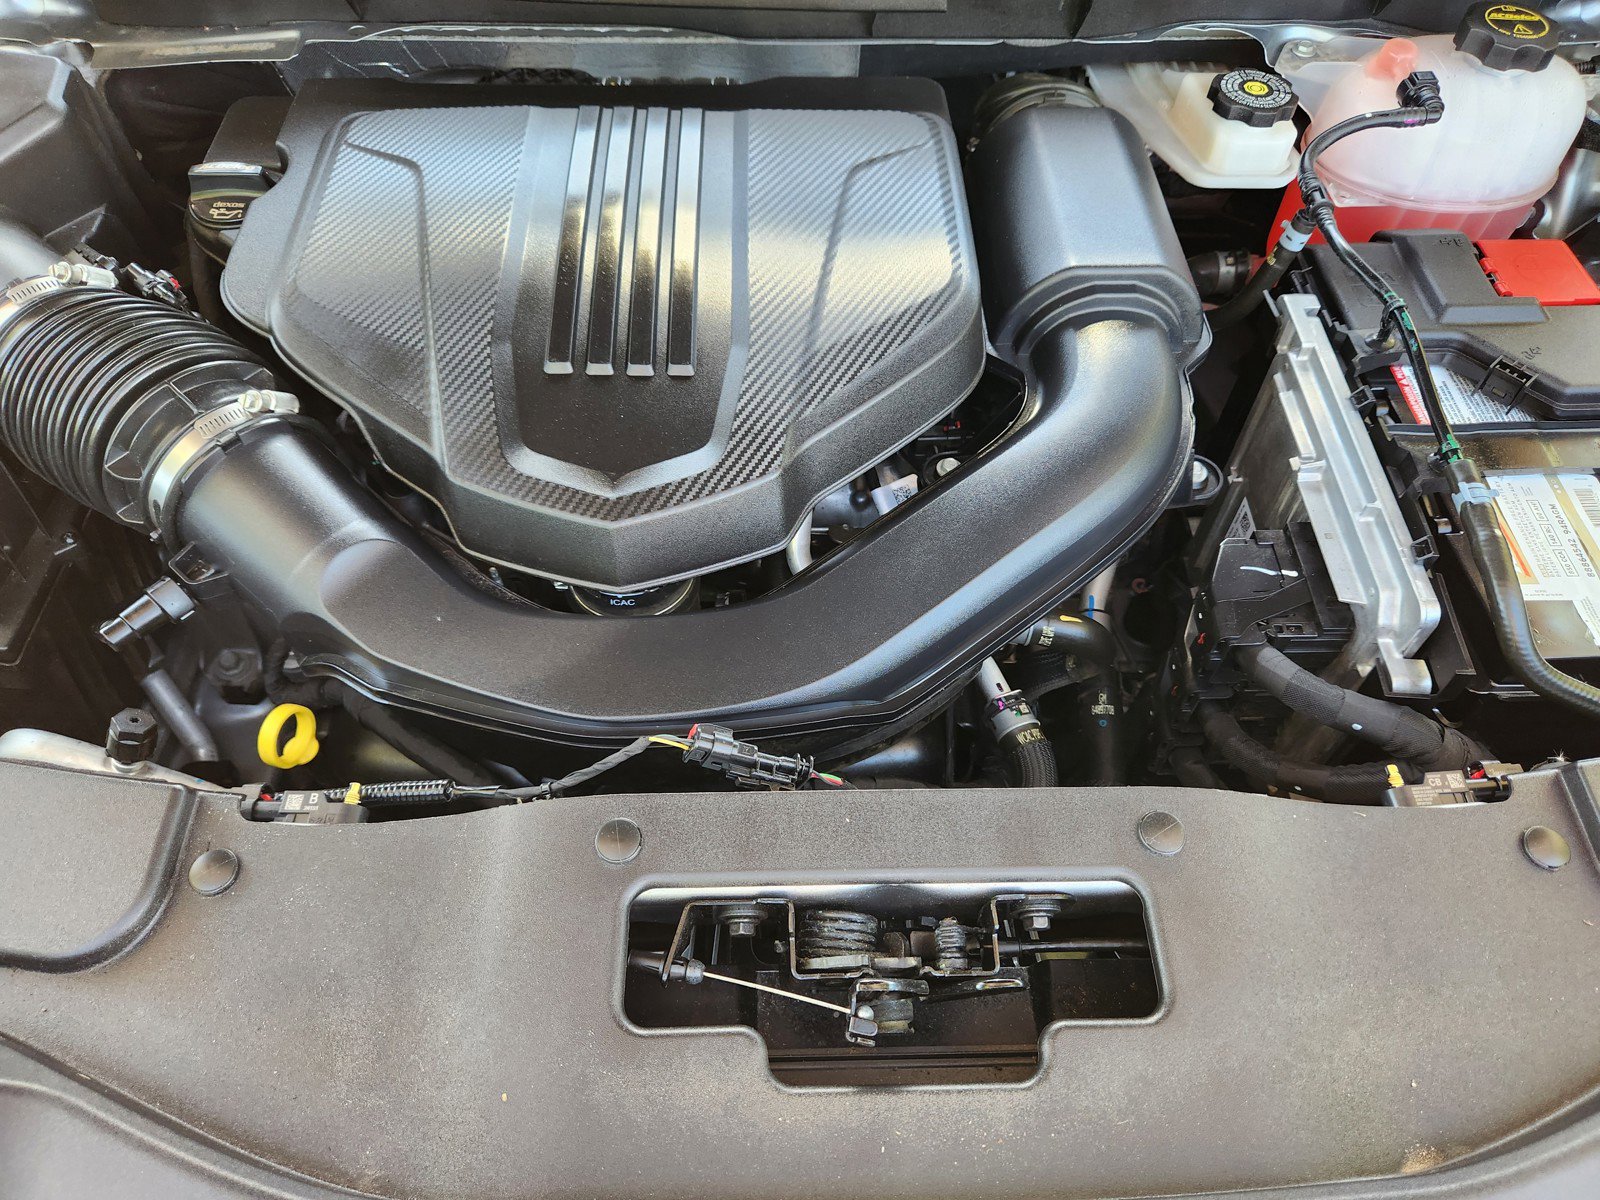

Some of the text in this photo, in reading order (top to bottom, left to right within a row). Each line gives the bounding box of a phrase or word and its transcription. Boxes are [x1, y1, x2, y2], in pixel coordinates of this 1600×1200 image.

[1489, 12, 1541, 21] ACDelco
[1548, 503, 1572, 534] 94RAGM
[1547, 534, 1557, 543] 140
[1557, 551, 1575, 575] 850 CCA
[1428, 778, 1442, 787] CB
[309, 792, 319, 804] B
